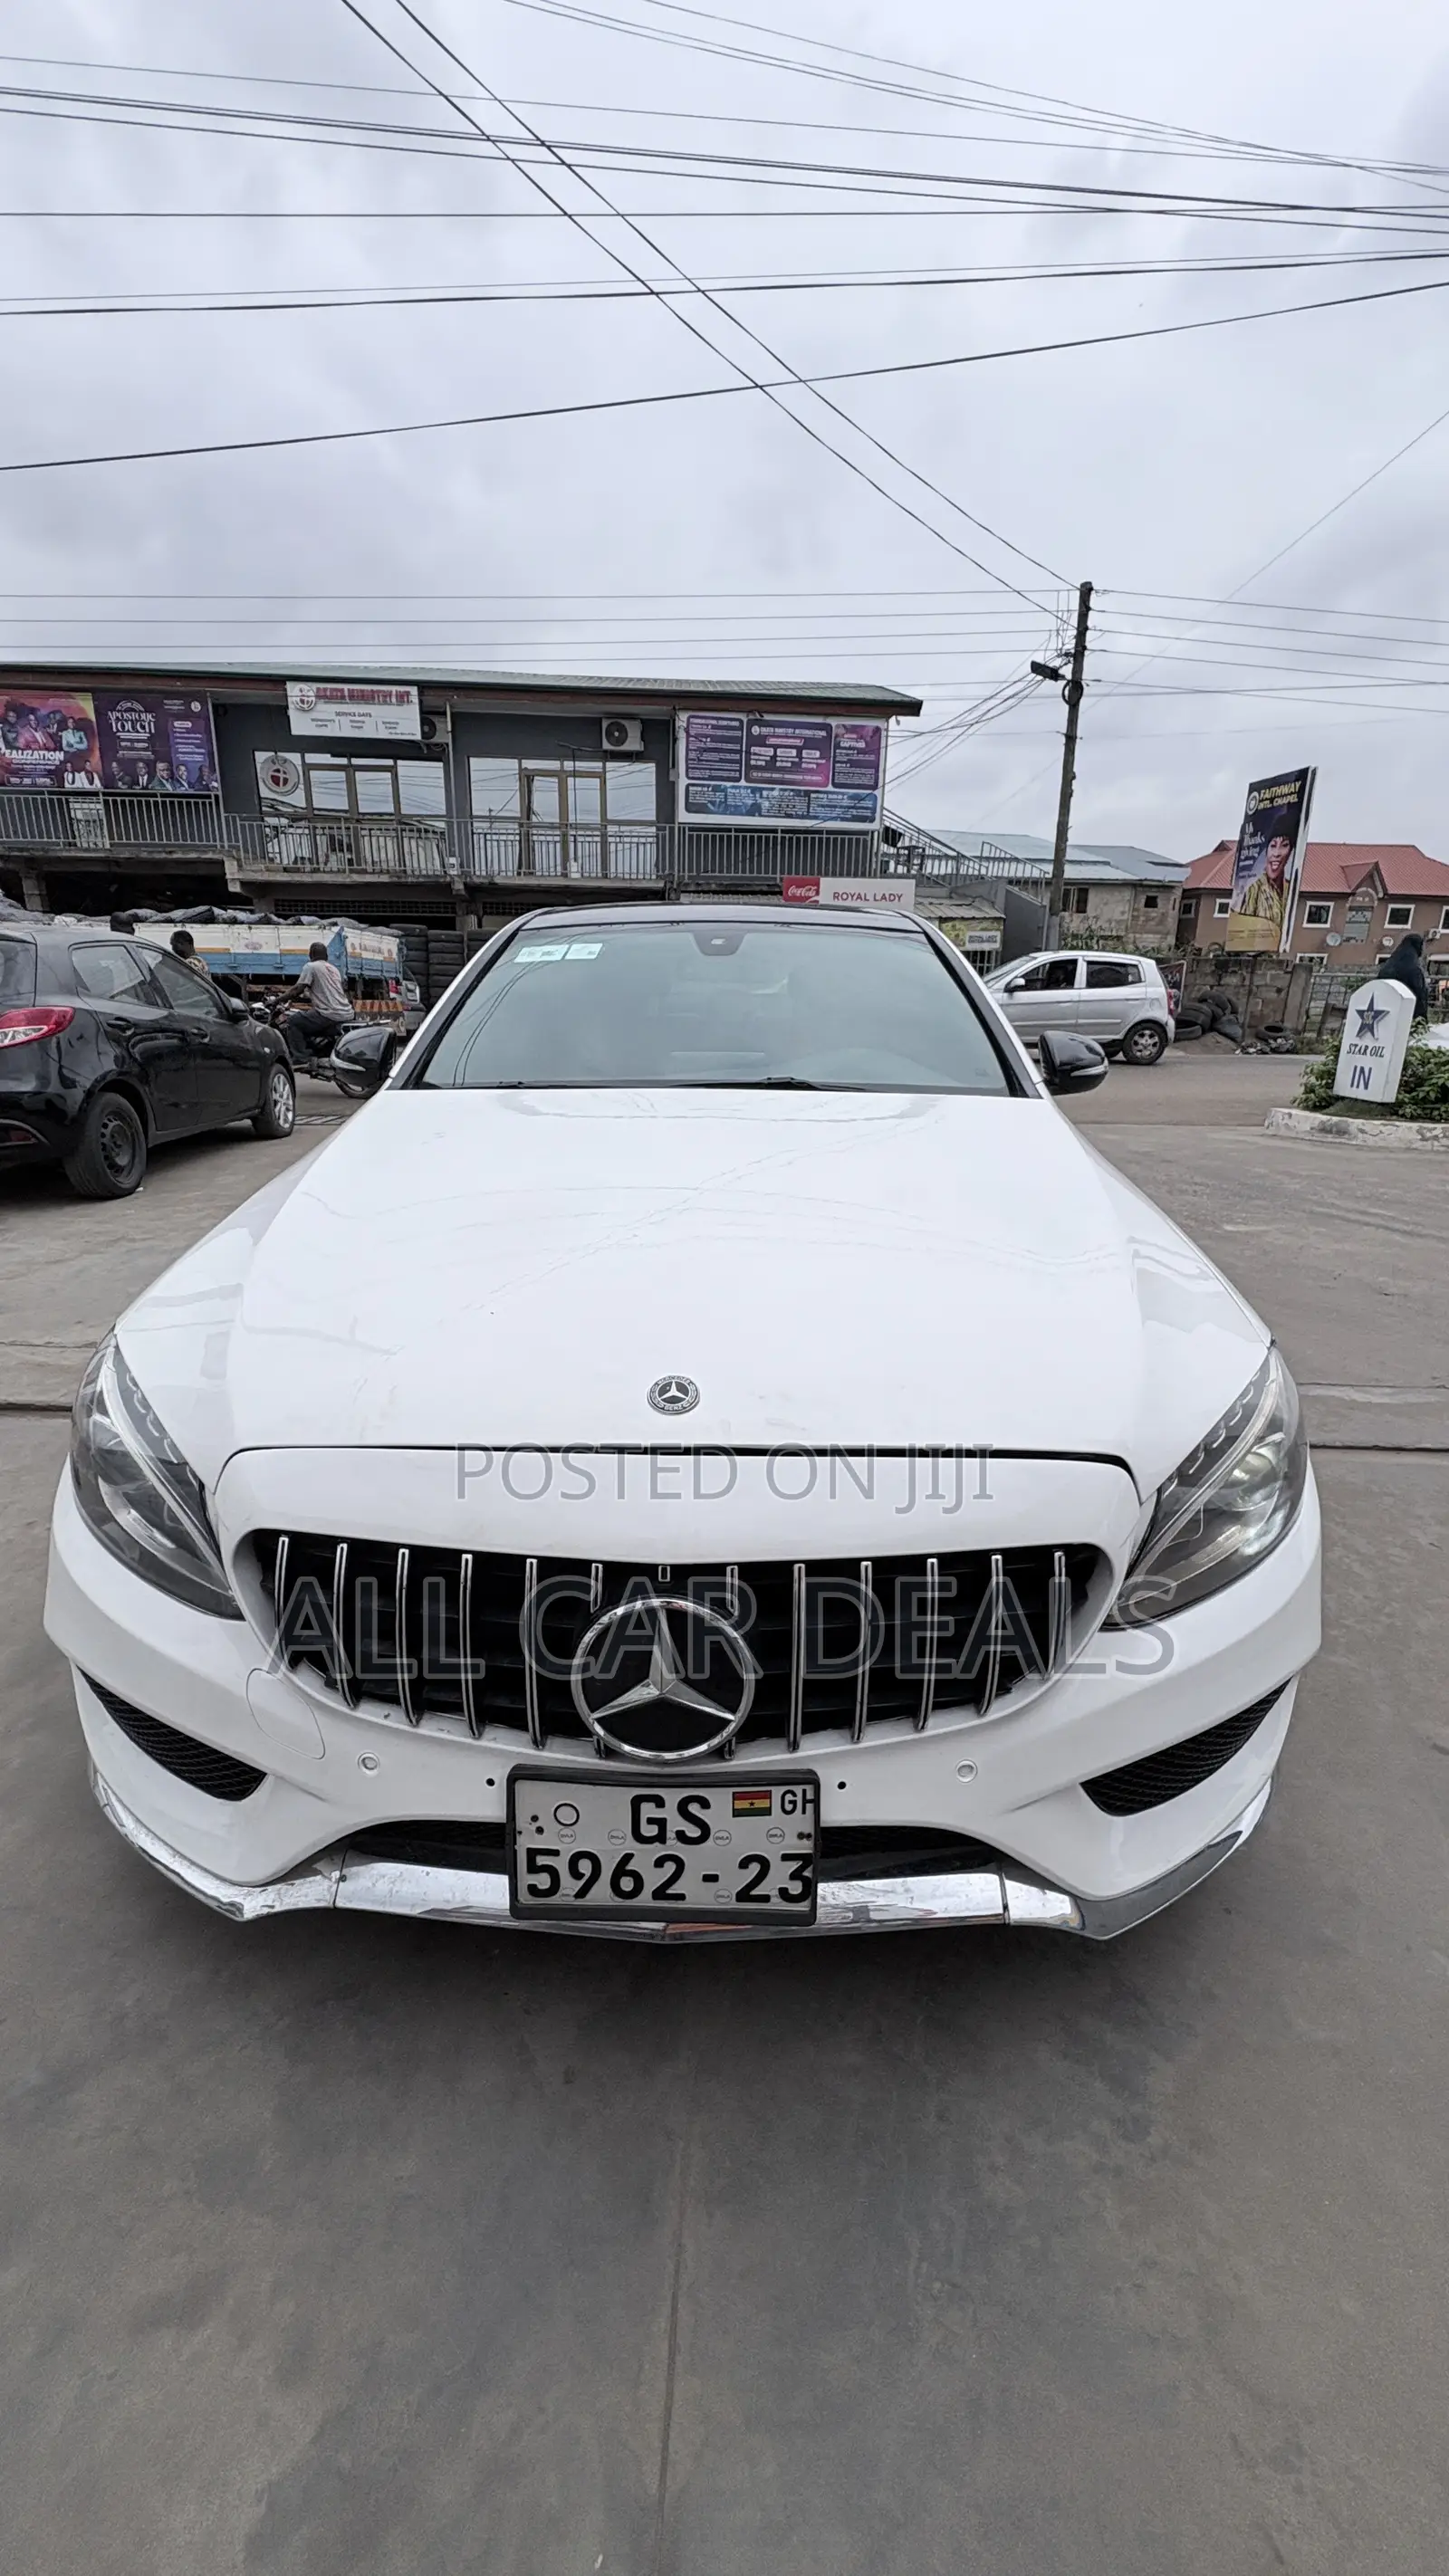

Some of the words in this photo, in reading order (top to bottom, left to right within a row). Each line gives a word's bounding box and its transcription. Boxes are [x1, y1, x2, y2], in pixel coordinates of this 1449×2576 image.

[108, 711, 156, 722] APOSTOLIC
[110, 721, 155, 733] TOUCH
[1, 749, 64, 761] EALIZATION
[1260, 780, 1302, 800] FAITHWAY
[1273, 795, 1299, 807] CHAPEL
[833, 892, 869, 902] ROYAL
[873, 893, 904, 903] LADY
[1347, 1043, 1368, 1056] STAR
[1369, 1046, 1386, 1058] OIL
[1349, 1065, 1372, 1090] IN
[630, 1794, 711, 1845] GS
[780, 1789, 815, 1815] GH
